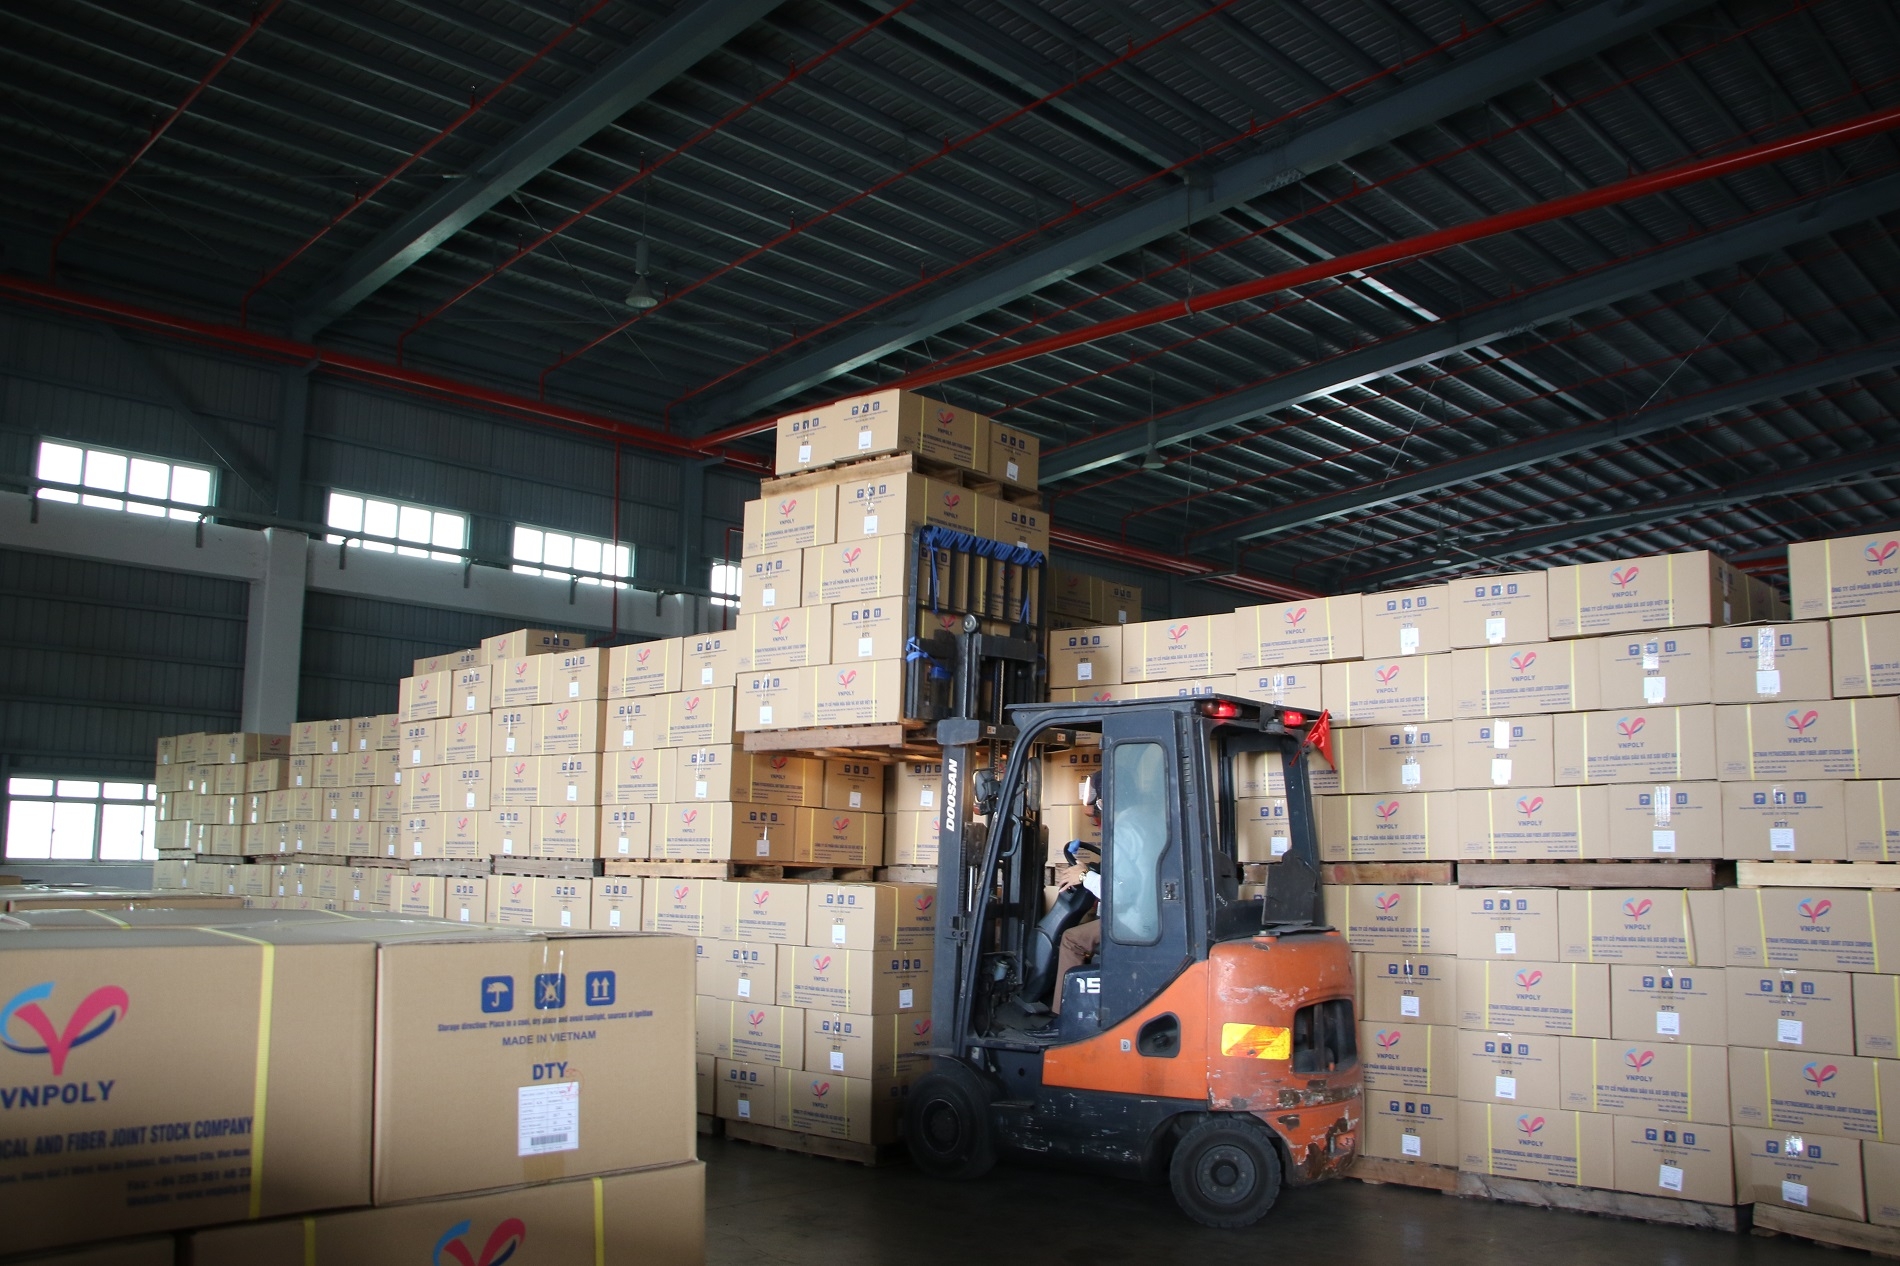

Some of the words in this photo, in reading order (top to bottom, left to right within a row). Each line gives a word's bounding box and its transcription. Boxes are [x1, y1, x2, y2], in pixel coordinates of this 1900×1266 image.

[1866, 567, 1898, 577] VNPOLY
[1611, 590, 1638, 598] VNPOLY
[1511, 674, 1535, 682] VNPOLY
[946, 758, 957, 832] DOOSAN
[1800, 925, 1830, 933] VNPOLY
[1076, 977, 1100, 993] 15
[502, 1034, 533, 1046] MADE
[536, 1033, 547, 1043] IN
[550, 1030, 596, 1042] VIETNAM
[533, 1062, 568, 1080] DTY
[1626, 1074, 1653, 1082] VNPOLY
[1, 1080, 115, 1109] VNPOLY
[1805, 1089, 1837, 1098] VNPOLY
[34, 1134, 63, 1155] AND
[67, 1130, 106, 1152] FIBER
[110, 1127, 147, 1148] JOINT
[150, 1122, 191, 1143] STOCK
[194, 1116, 253, 1139] COMPANY
[1518, 1139, 1544, 1147] VNPOLY
